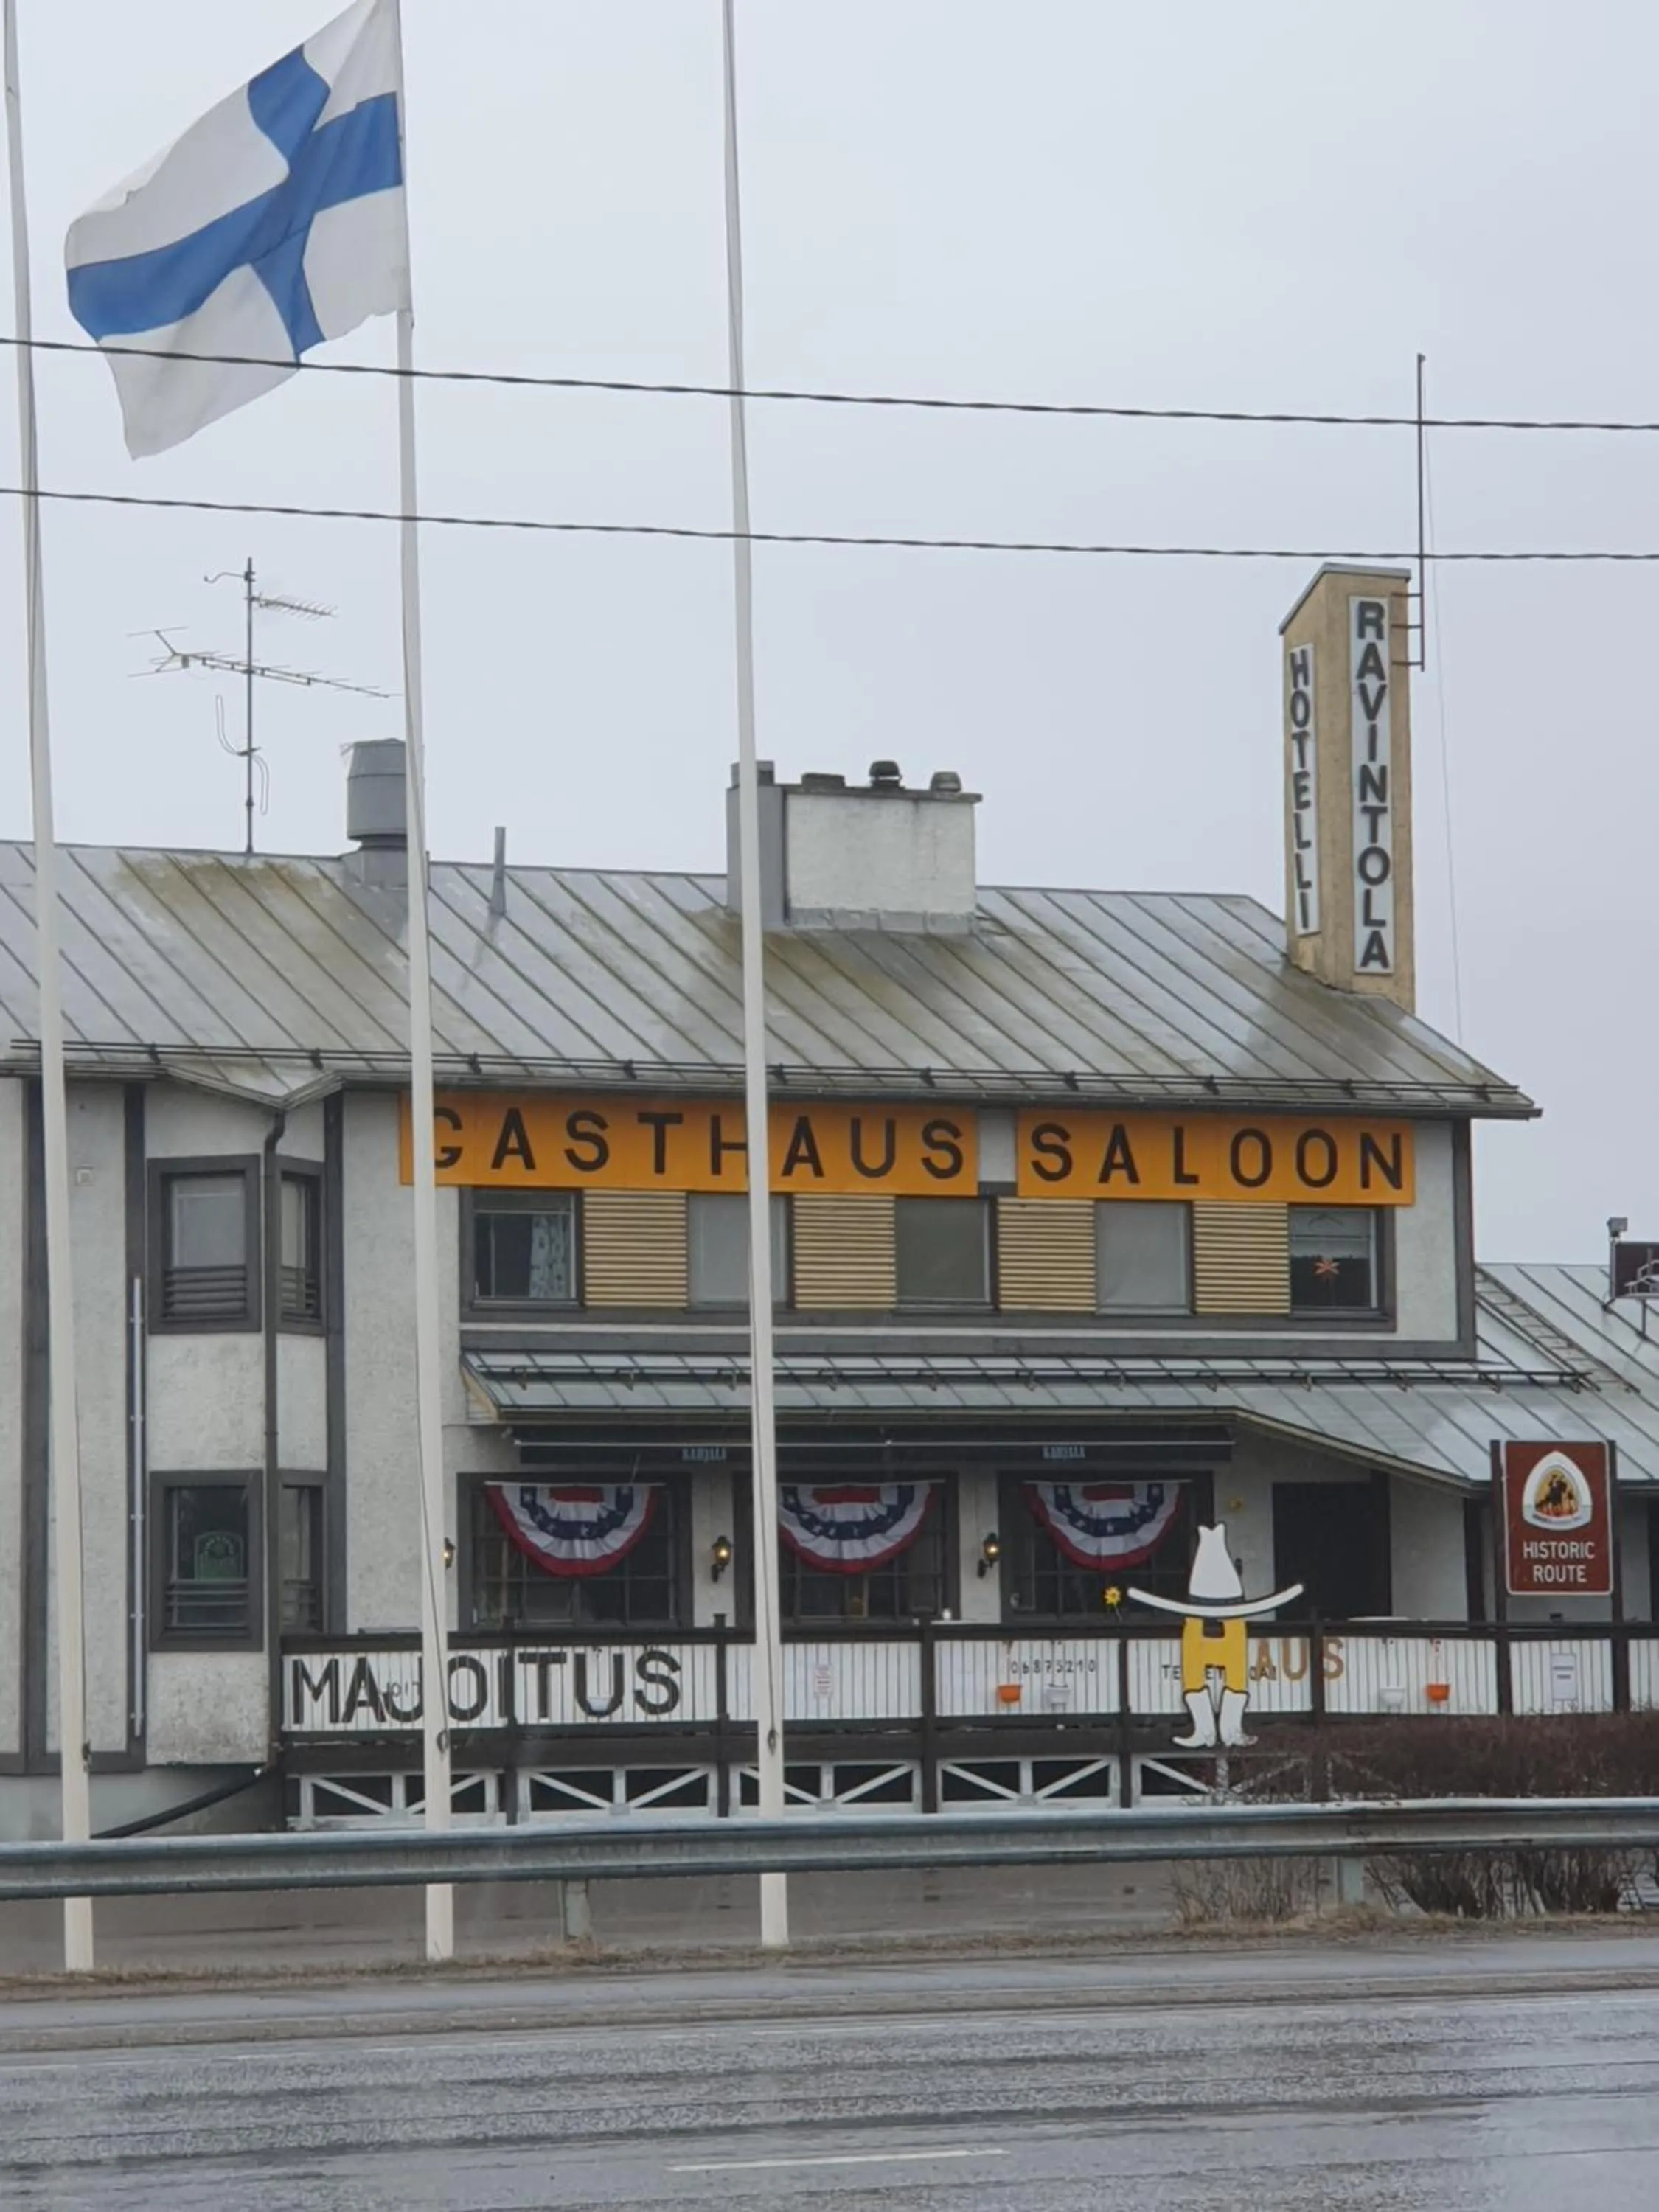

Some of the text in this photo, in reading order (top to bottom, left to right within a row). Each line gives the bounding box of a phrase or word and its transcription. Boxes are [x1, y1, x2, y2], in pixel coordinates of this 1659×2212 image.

[1289, 649, 1312, 930] HOTELLI
[1355, 600, 1391, 969] RAVINTOLA
[433, 1107, 1403, 1189] GASTHAUS SALOON
[1523, 1540, 1596, 1560] HISTORIC
[1533, 1564, 1587, 1583] ROUTE
[292, 1649, 681, 1725] MAJOITUS
